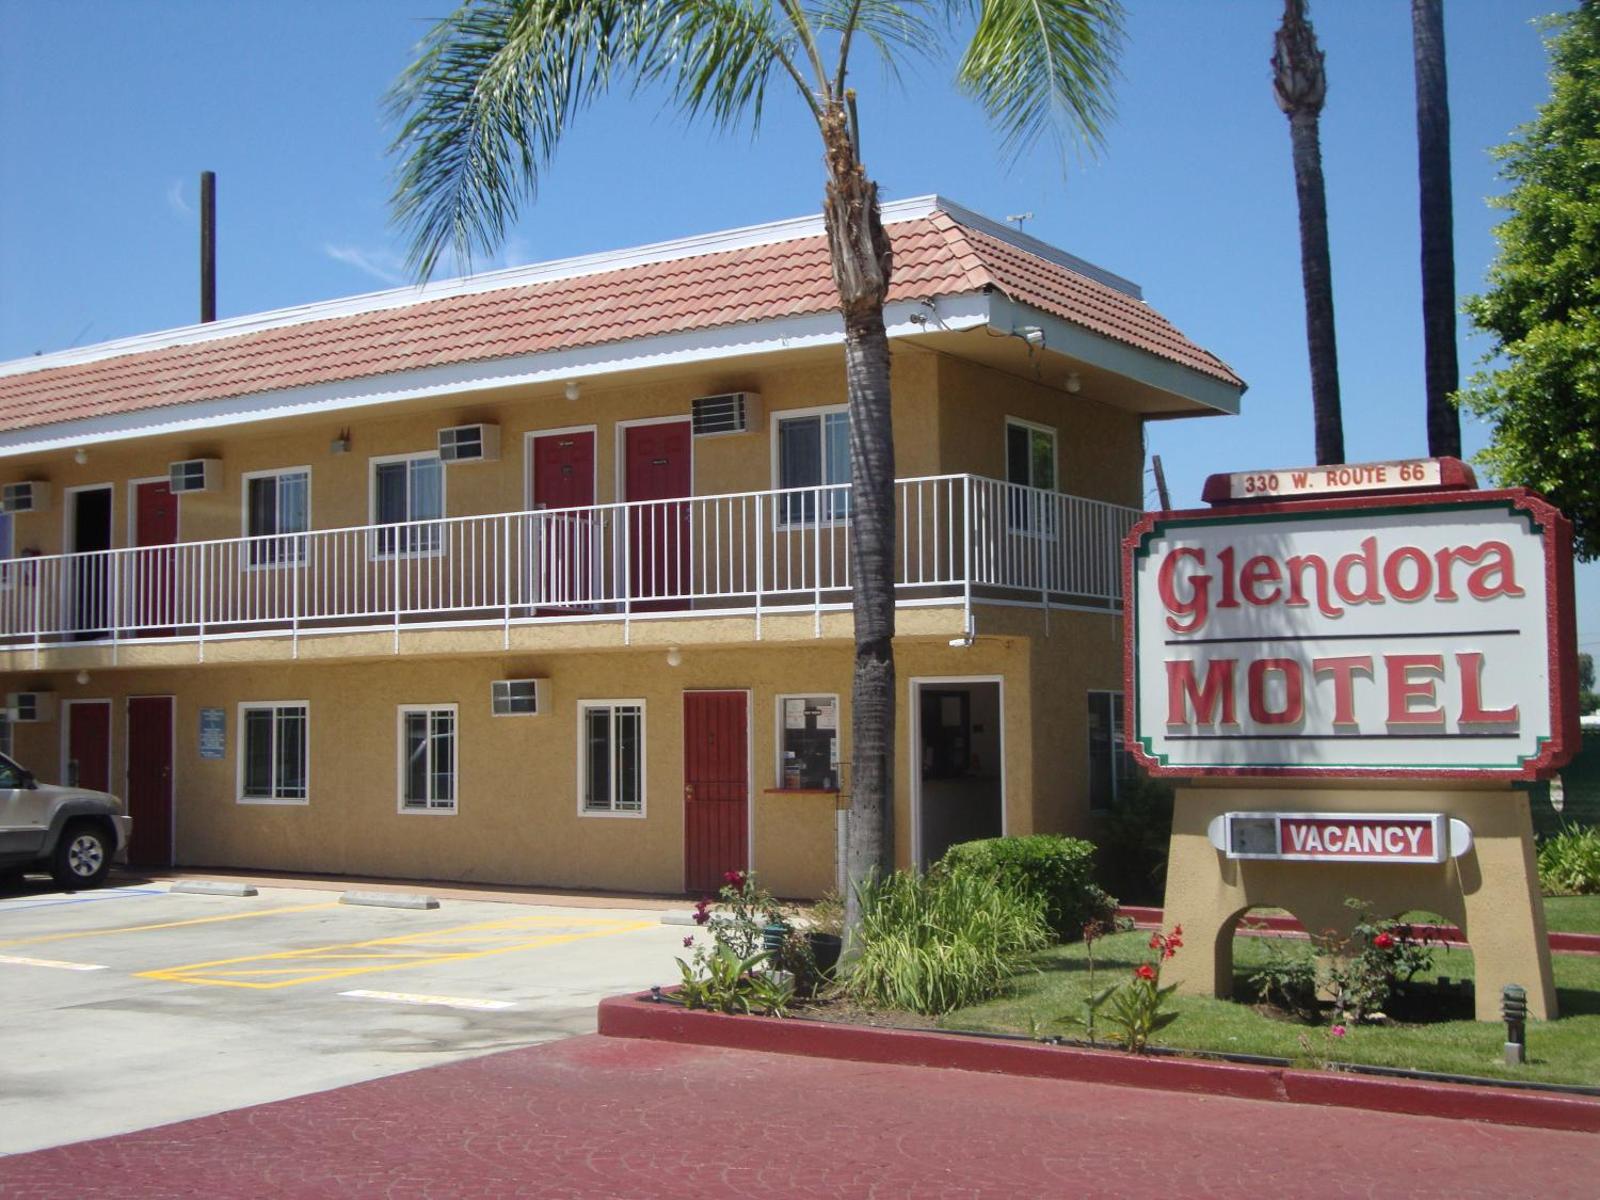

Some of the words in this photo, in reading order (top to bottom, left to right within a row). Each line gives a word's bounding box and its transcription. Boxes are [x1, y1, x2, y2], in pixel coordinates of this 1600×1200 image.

[1245, 475, 1279, 493] 330
[1292, 472, 1313, 489] W.
[1326, 466, 1387, 487] ROUTE
[1400, 464, 1425, 481] 66
[1158, 537, 1524, 633] Glendora
[1165, 653, 1520, 726] MOTEL
[1289, 825, 1424, 854] VACANCY
